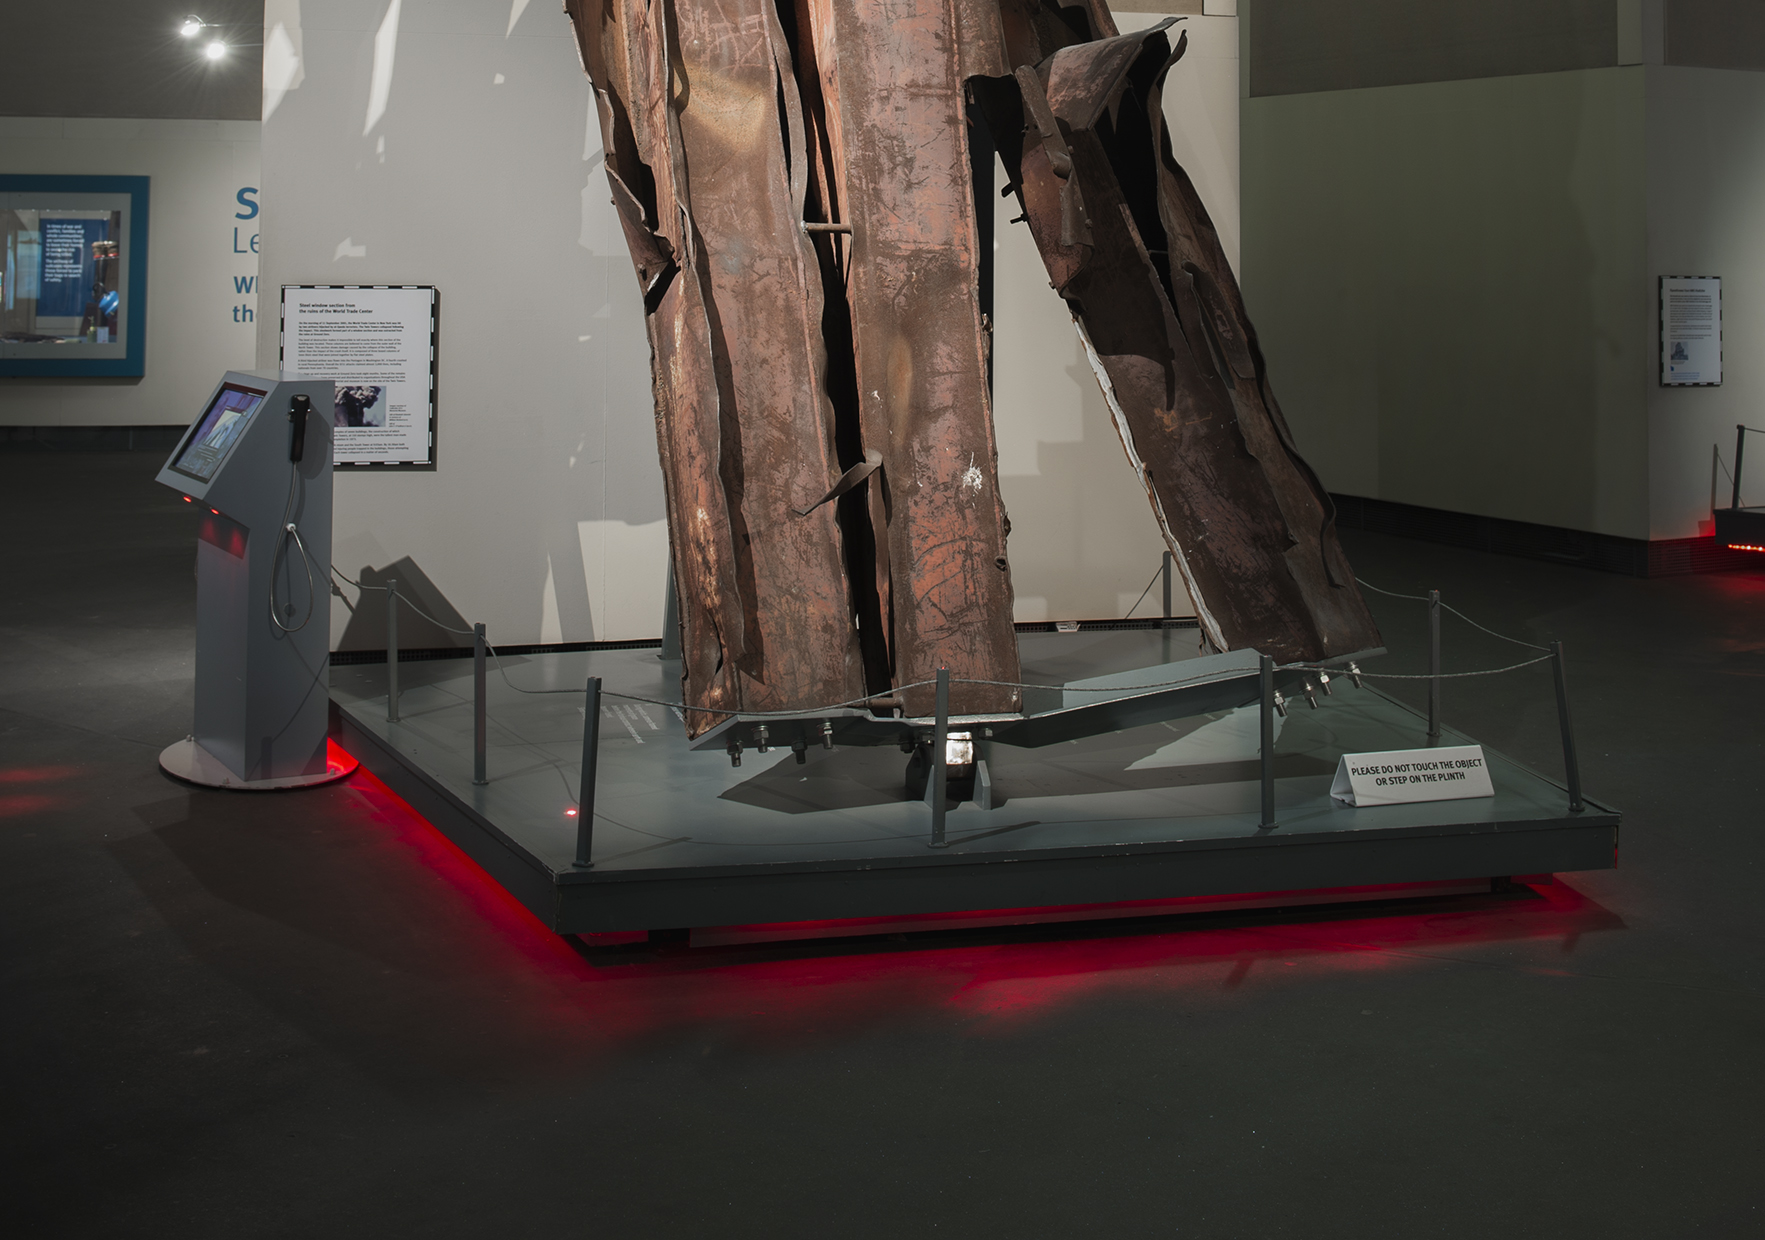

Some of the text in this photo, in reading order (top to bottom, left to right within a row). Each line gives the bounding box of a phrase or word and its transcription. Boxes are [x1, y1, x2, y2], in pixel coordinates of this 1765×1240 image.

[232, 304, 258, 322] th
[1352, 759, 1482, 776] PLEASE DO NOT TOUCH THE OBJECT
[1376, 772, 1465, 786] OR STEP ON THE PLINTH
